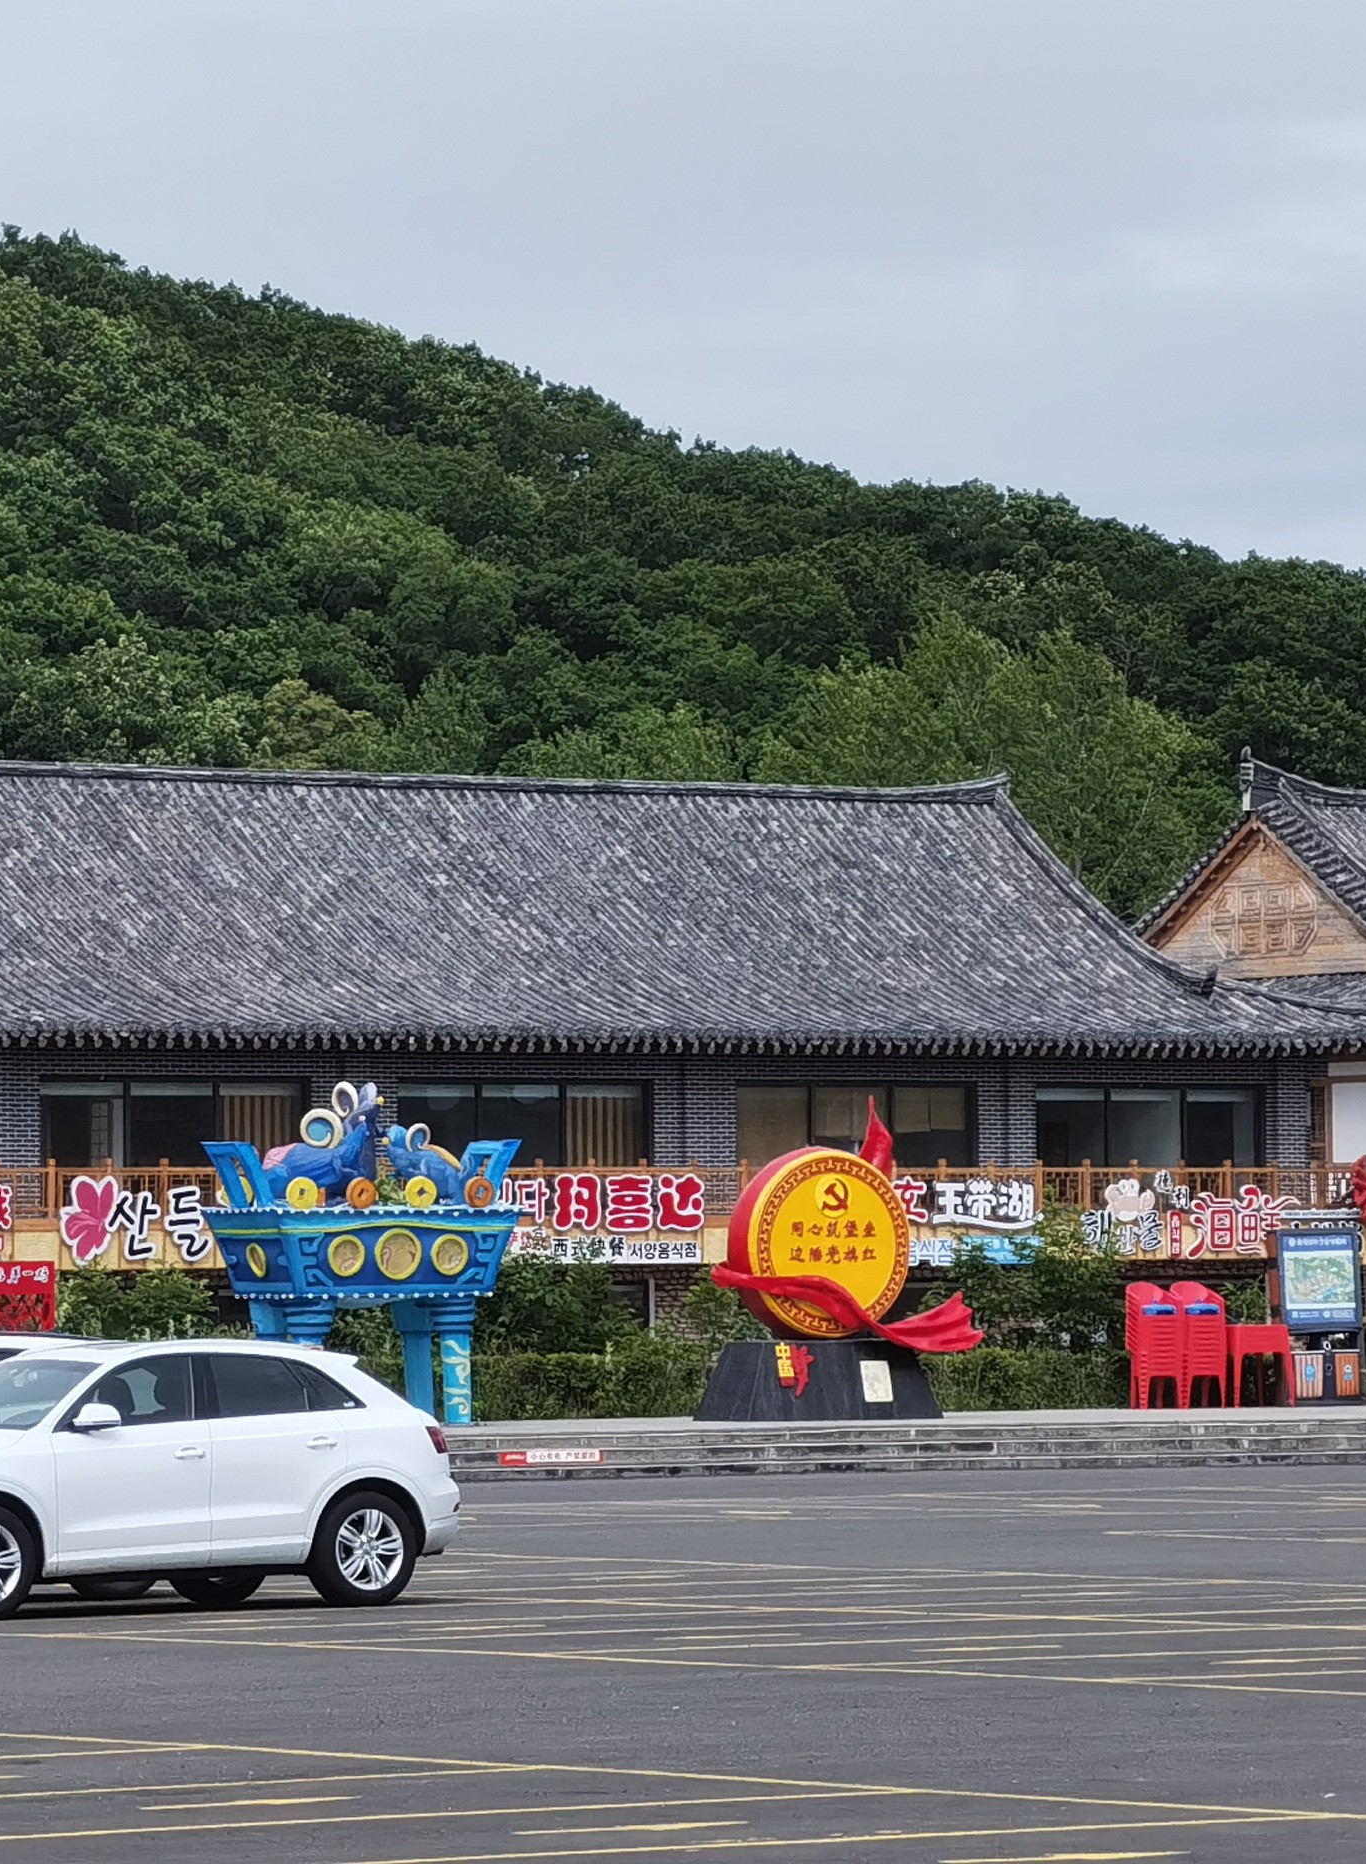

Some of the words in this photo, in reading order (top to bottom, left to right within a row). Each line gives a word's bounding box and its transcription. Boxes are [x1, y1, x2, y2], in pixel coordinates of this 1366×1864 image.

[106, 1185, 212, 1260] 산들
[933, 1179, 1036, 1226] 玉带湖
